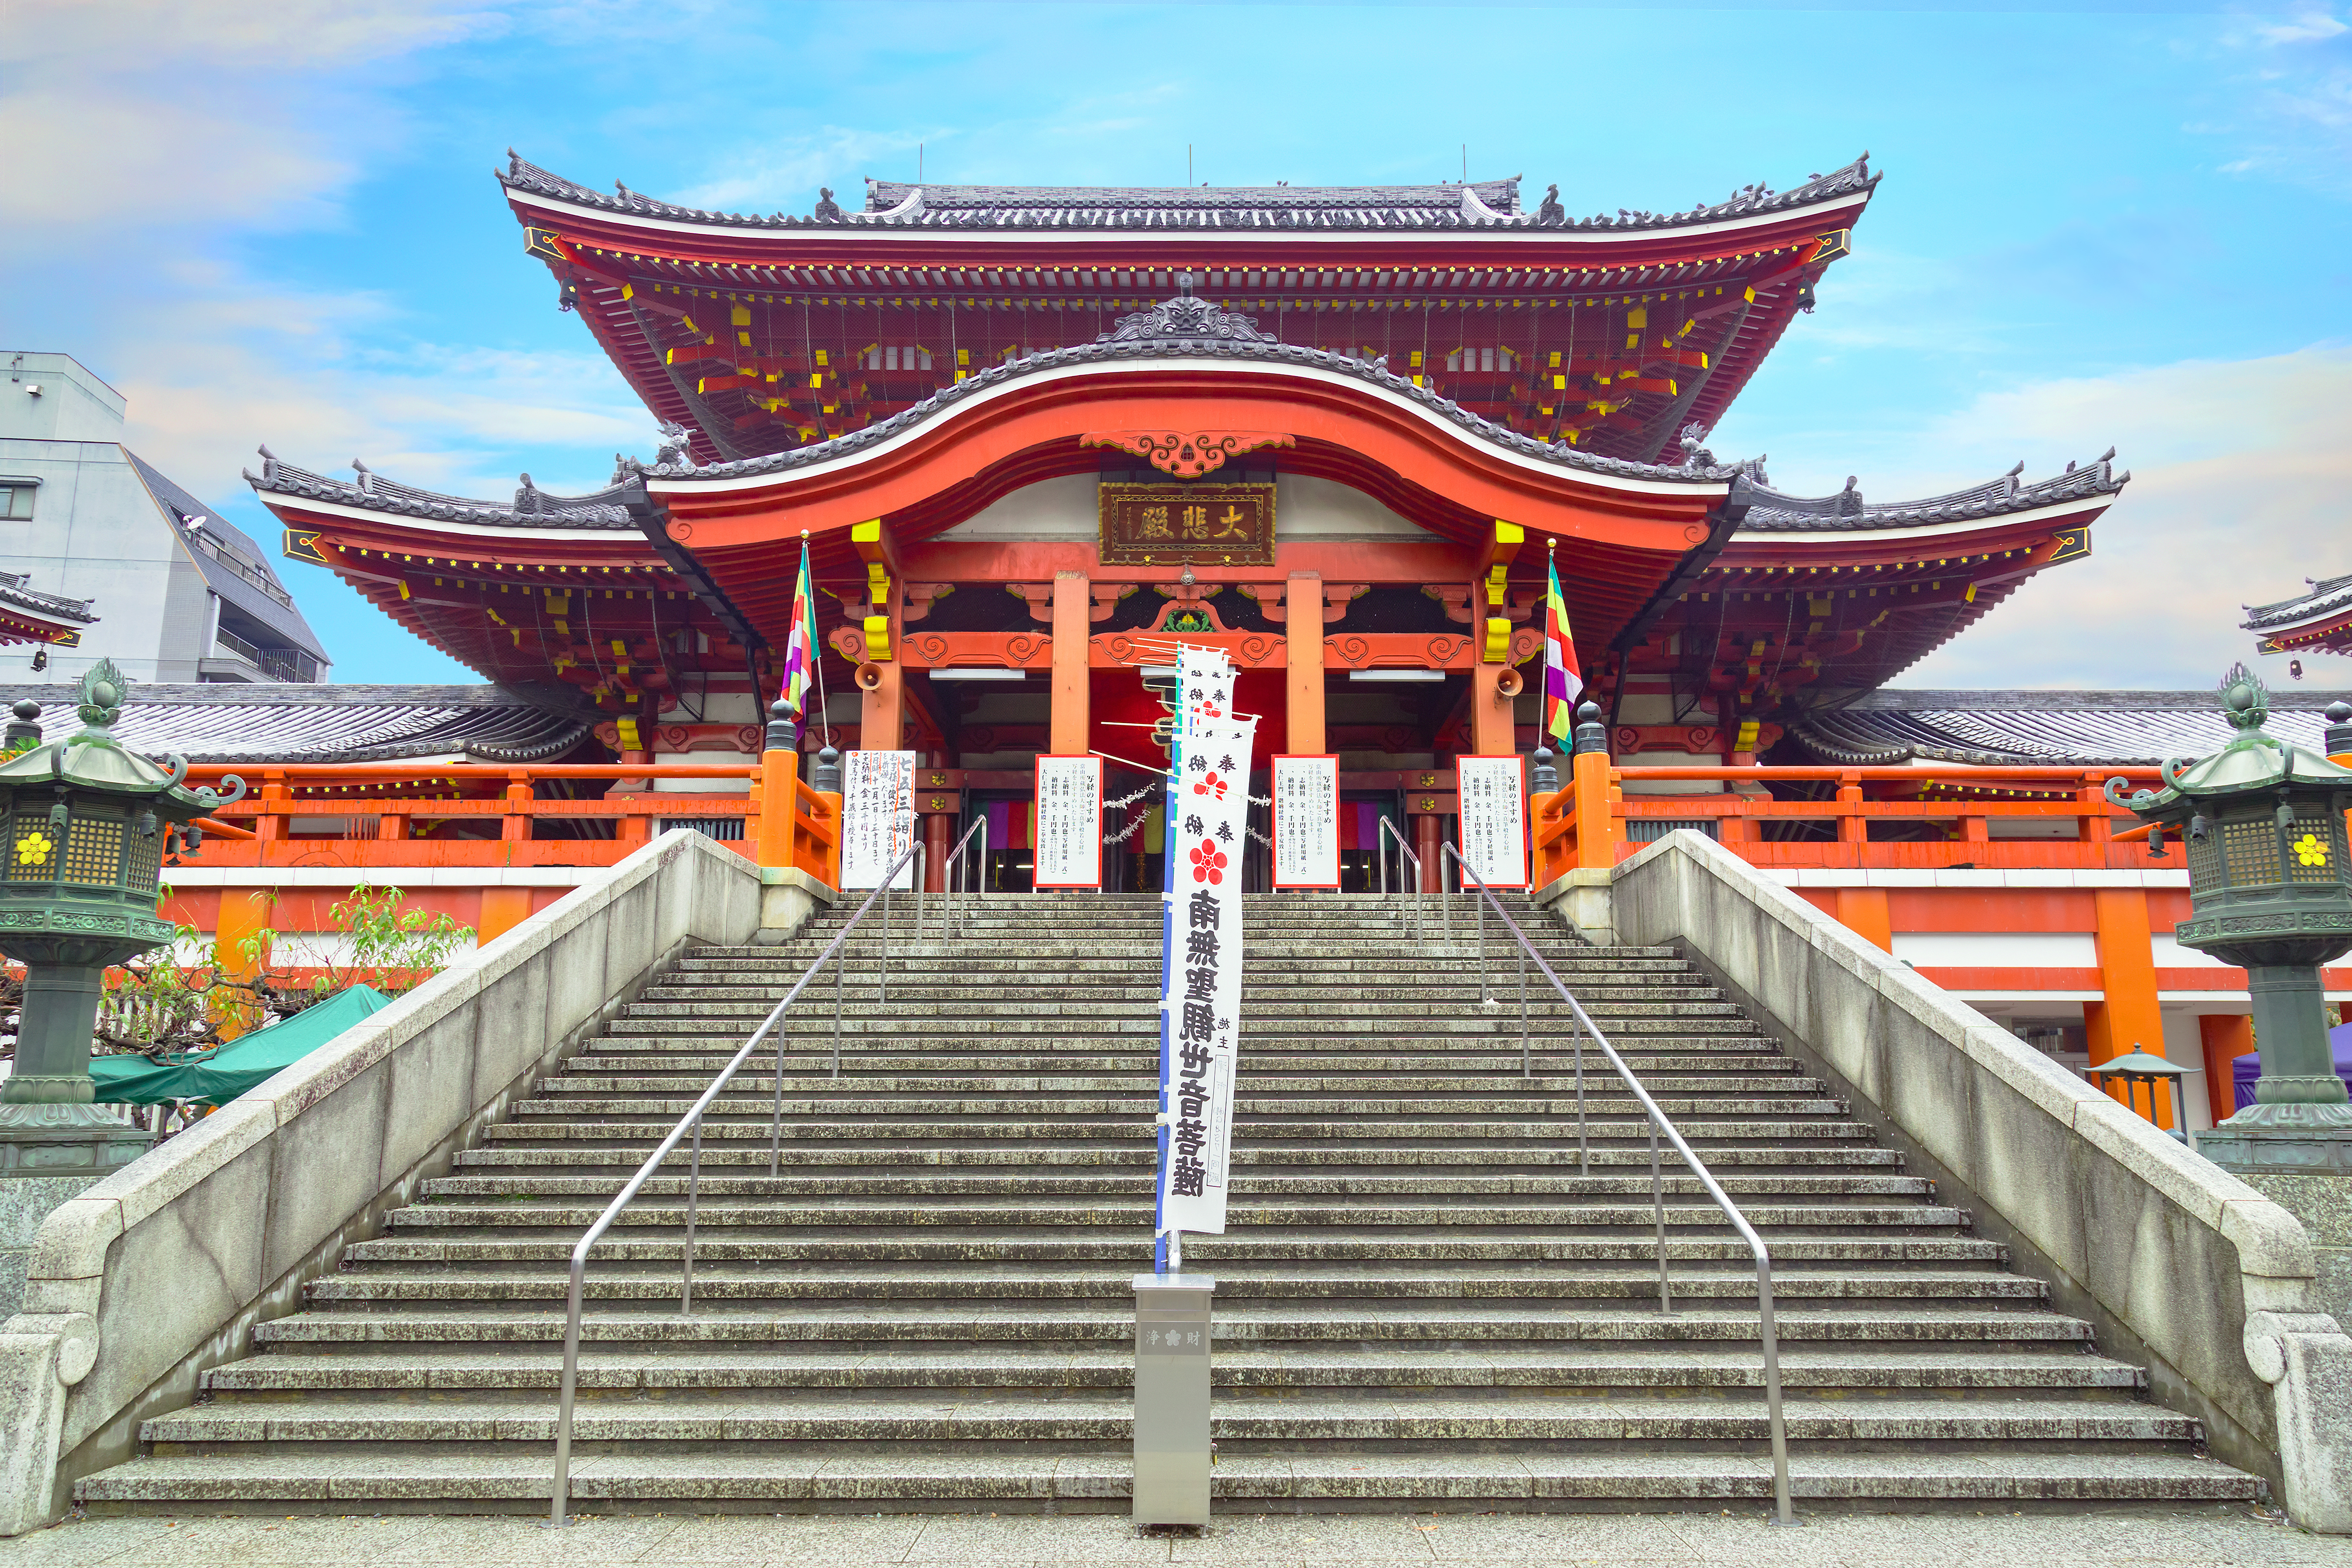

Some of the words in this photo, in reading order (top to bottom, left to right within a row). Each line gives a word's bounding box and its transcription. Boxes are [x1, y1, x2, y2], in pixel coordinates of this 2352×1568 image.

[1135, 505, 1248, 541] 大悲殿
[880, 753, 890, 820] を祈願いたします。
[895, 757, 912, 856] 七五三詣り
[1508, 776, 1517, 824] 写経のすすめ
